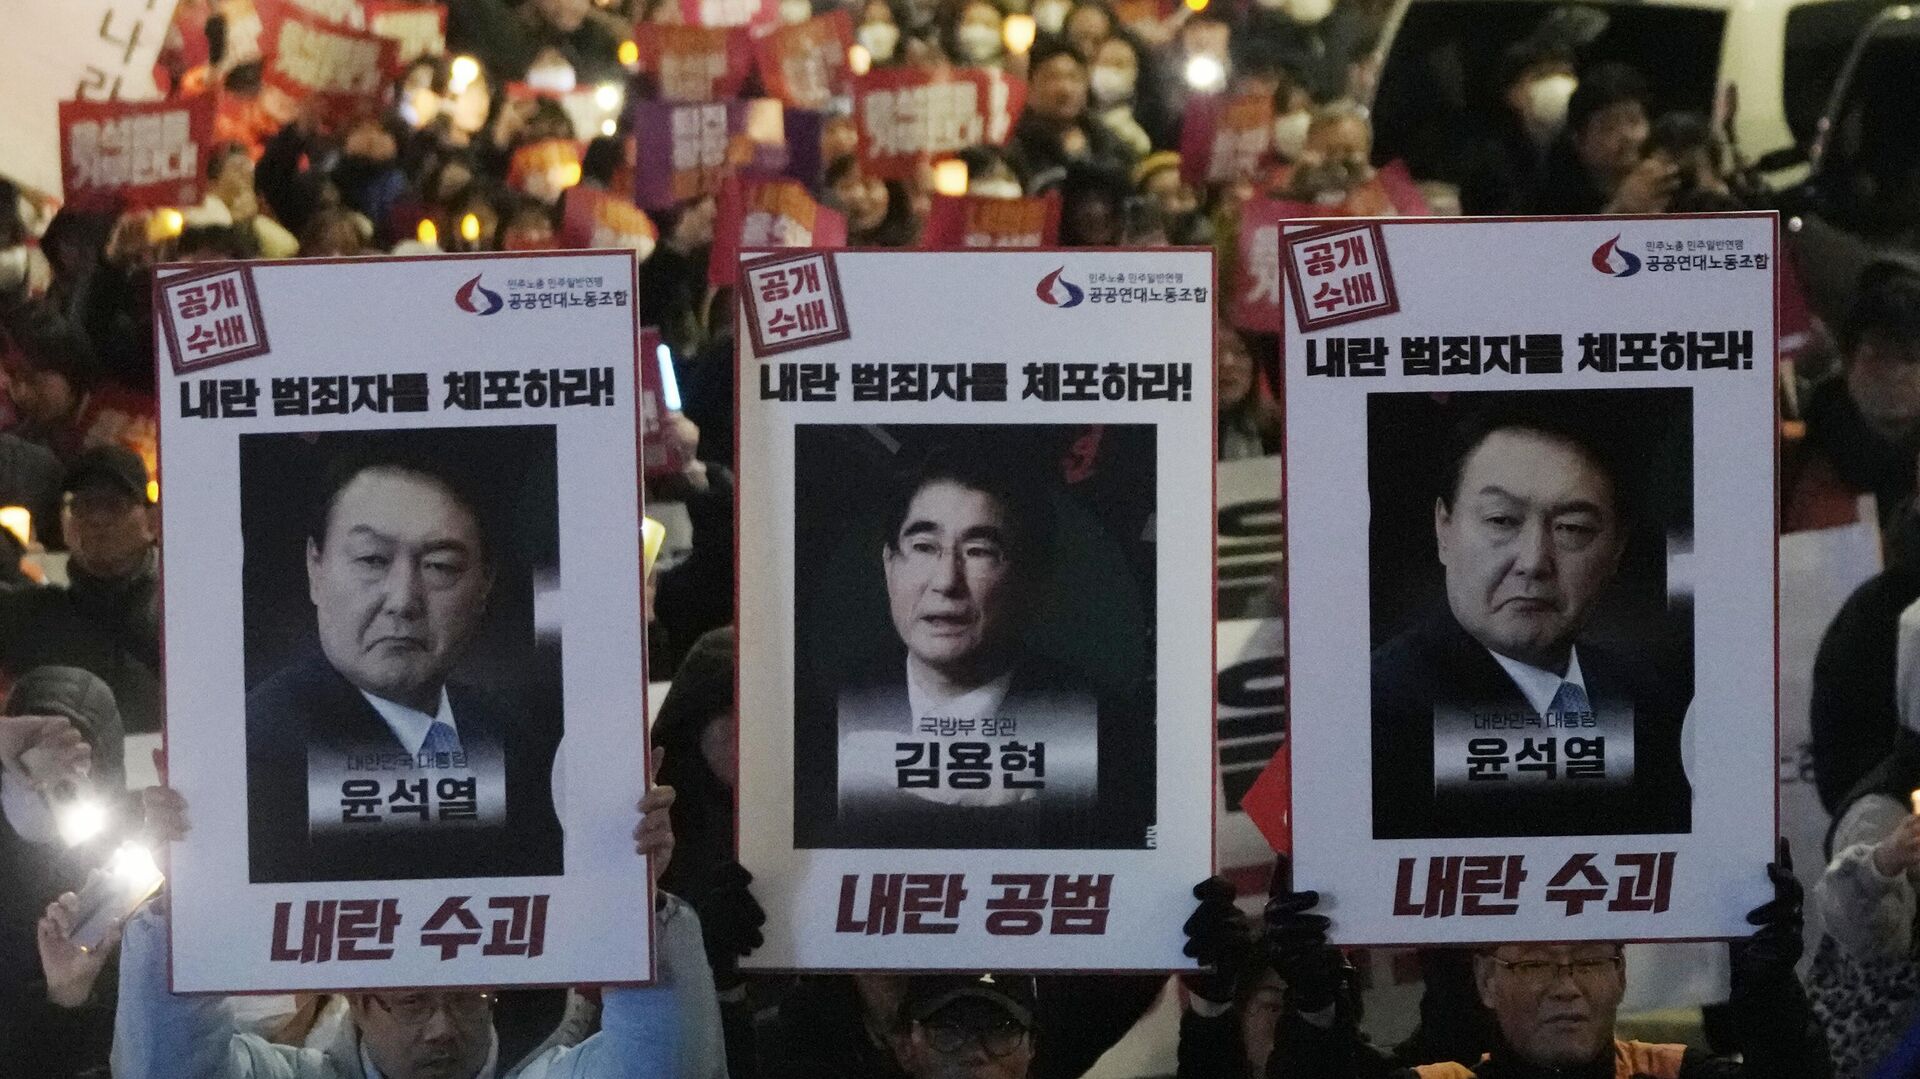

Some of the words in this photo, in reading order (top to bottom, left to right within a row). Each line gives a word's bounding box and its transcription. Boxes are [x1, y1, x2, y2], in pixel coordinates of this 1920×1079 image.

[1302, 234, 1369, 277] 공개
[1645, 240, 1684, 252] 민주노총
[1645, 253, 1770, 272] 공공연대노동조합
[176, 277, 240, 318] 공개
[507, 290, 628, 310] 공공연대노동조합
[758, 262, 822, 302] 공개
[1088, 287, 1208, 304] 공공연대노동조합
[1312, 271, 1378, 313] 수배
[186, 314, 249, 354] 수배
[767, 298, 829, 338] 수배
[1305, 336, 1390, 378] 내란
[1400, 333, 1564, 376] 범죄자를
[1577, 330, 1754, 374] 체포하라!
[180, 377, 261, 419] 내란
[271, 372, 431, 416] 범죄자를
[443, 366, 615, 411] 체포하라!
[760, 363, 840, 401] 내란
[851, 363, 1008, 401] 범죄자를
[1022, 362, 1193, 401] 체포하라!
[920, 717, 976, 737] 국방부
[981, 717, 1018, 737] 장관
[1474, 712, 1541, 730] 대한민국
[1546, 711, 1599, 729] 대통령
[347, 752, 413, 771] 대한민국
[417, 751, 468, 770] 대통령
[895, 740, 1046, 790] 김용현
[1466, 736, 1606, 782] 윤석열
[341, 776, 478, 824] 윤석열
[835, 873, 968, 936] 내란
[985, 873, 1115, 936] 공범
[1392, 854, 1528, 919] 내란
[1545, 852, 1679, 917] 수괴
[270, 898, 403, 964] 내란
[420, 894, 550, 962] 수괴
